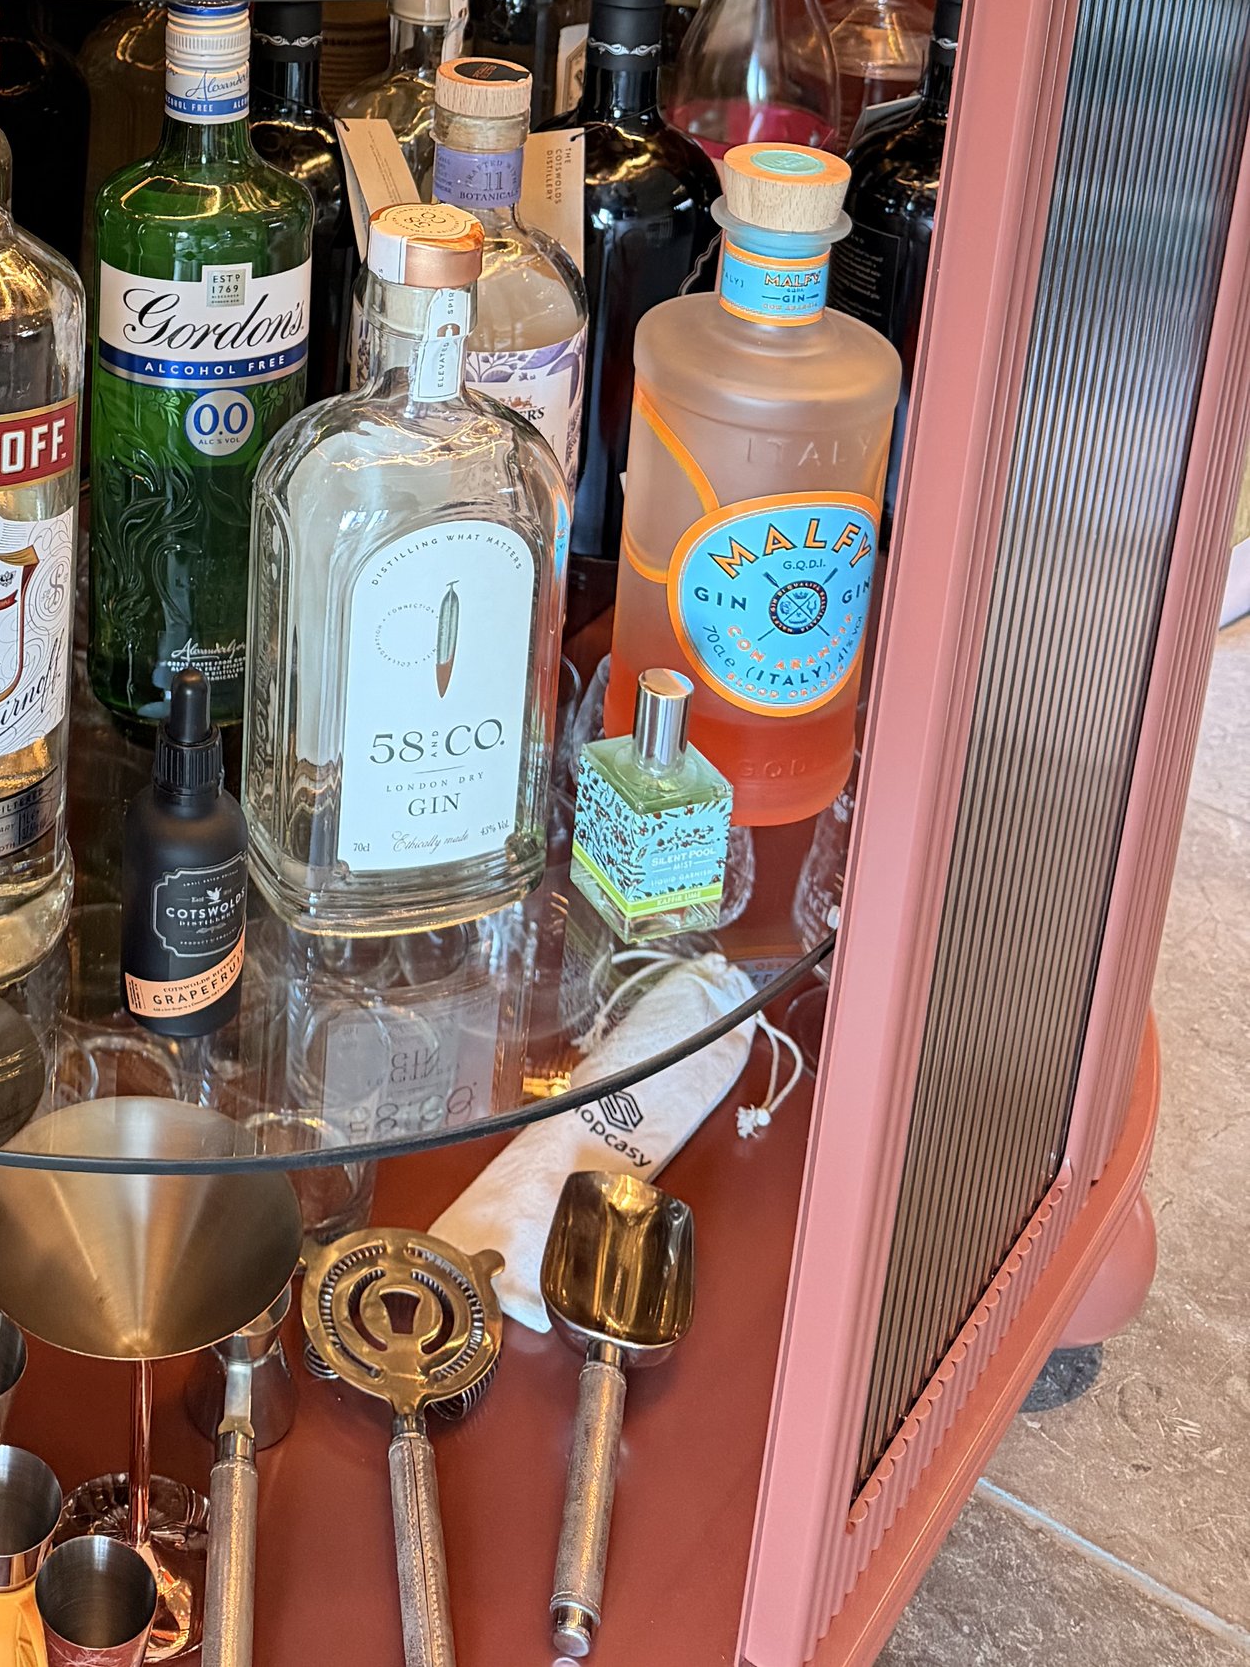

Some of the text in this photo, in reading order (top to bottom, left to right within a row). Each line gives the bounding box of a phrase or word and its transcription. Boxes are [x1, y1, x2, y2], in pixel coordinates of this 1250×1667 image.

[166, 96, 187, 110] LCOHOL
[191, 103, 213, 112] FREE
[545, 150, 554, 201] DISTILLERY
[554, 149, 563, 205] COTSWOLDS
[211, 285, 239, 294] 1769
[764, 271, 822, 288] MALFY
[782, 294, 805, 303] GIN
[123, 288, 305, 351] Gordon's
[144, 354, 286, 376] ALCOHOL FREE
[193, 402, 249, 436] 0.0
[198, 437, 216, 446] ALC
[224, 437, 241, 445] VOL
[748, 435, 870, 467] ITALY
[371, 533, 523, 586] DISTILLING WHAT MATTERS
[707, 518, 872, 580] MALFY
[693, 586, 748, 613] GIN
[841, 576, 871, 605] GIN
[746, 661, 832, 686] (ITALY)
[369, 731, 425, 764] 58
[430, 730, 439, 758] AND
[386, 771, 485, 793] LONDON DRY
[408, 792, 462, 817] GIN
[353, 842, 371, 852] 70cl
[391, 828, 469, 855] Ethically made
[651, 847, 717, 867] SILENT POOL
[672, 860, 693, 871] MIST
[651, 875, 677, 887] LIQUID
[166, 886, 245, 919] COTSWOLDS
[179, 909, 235, 927] DISTILLERY
[163, 976, 211, 993] COTSWOLDS
[576, 1107, 653, 1168] opcasy
